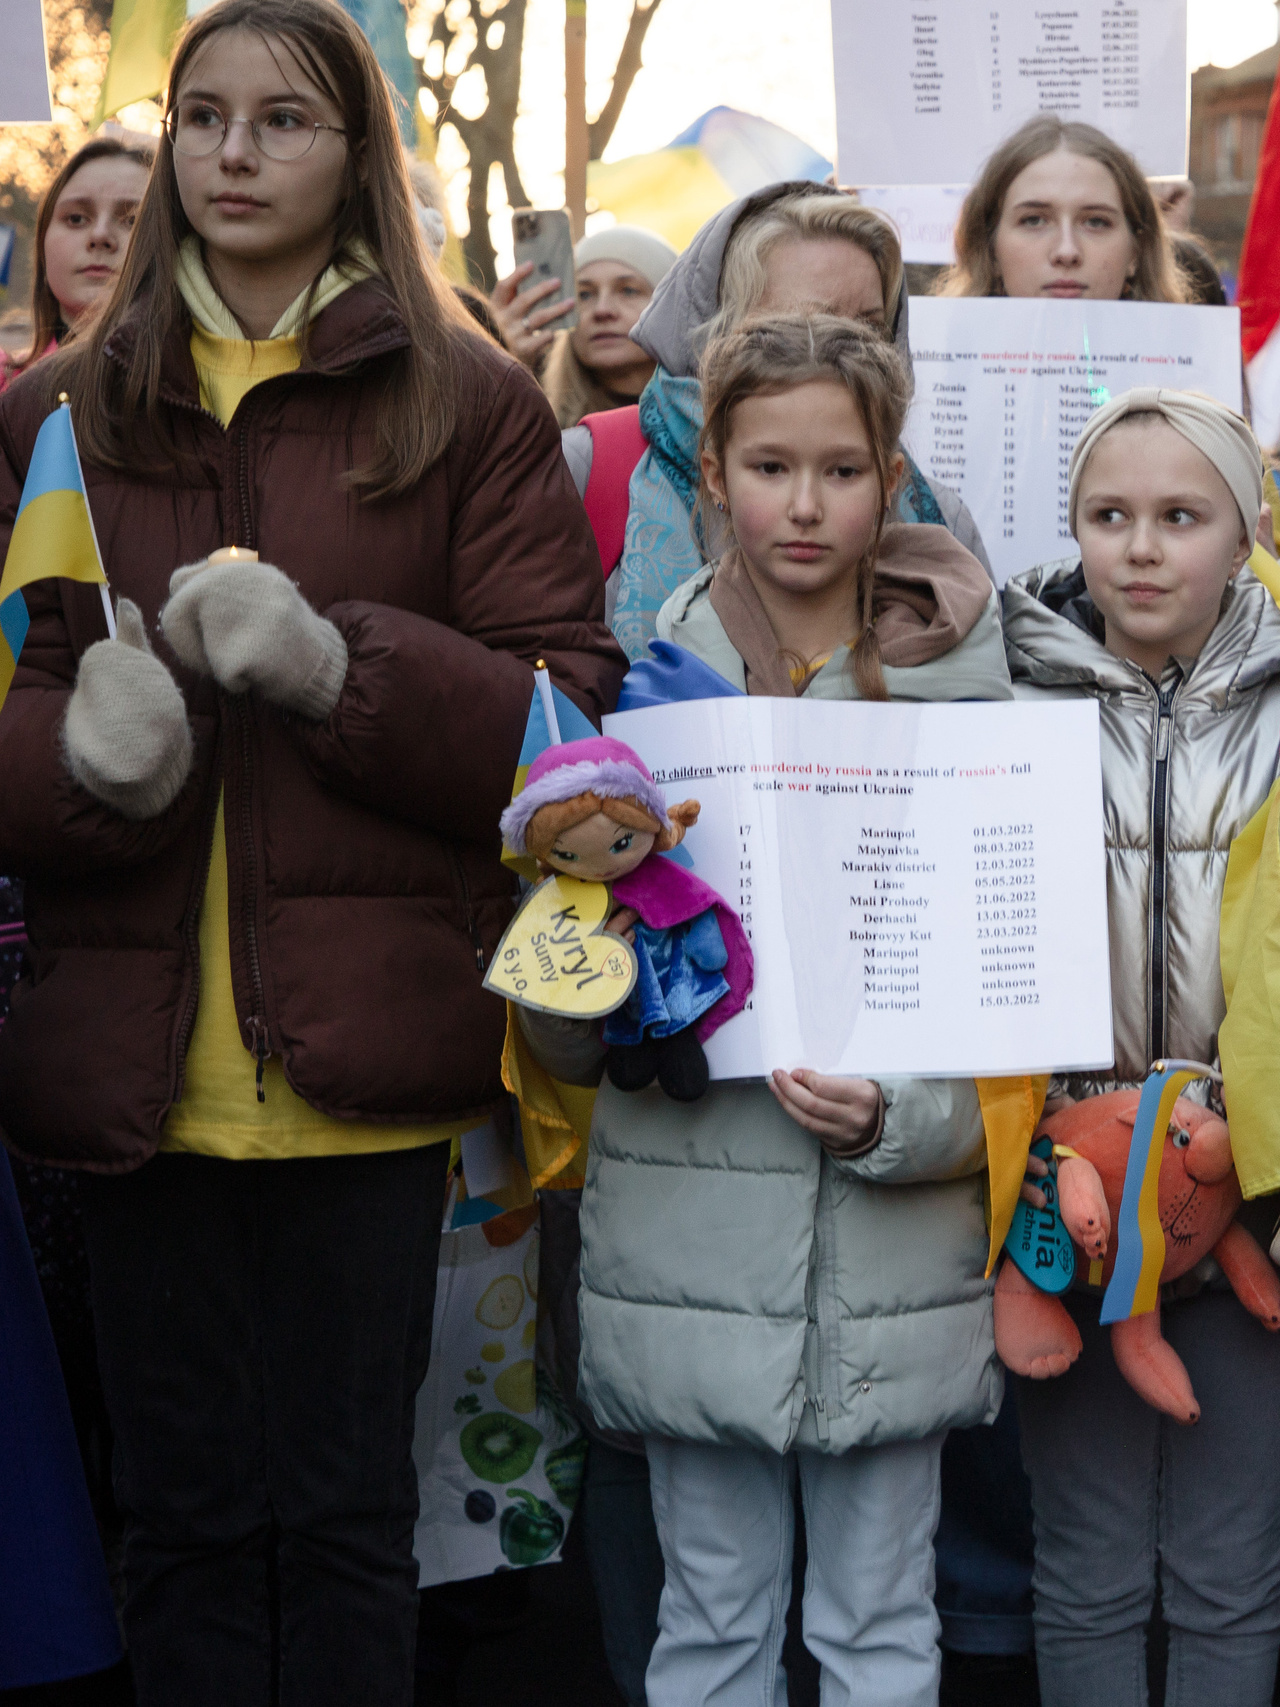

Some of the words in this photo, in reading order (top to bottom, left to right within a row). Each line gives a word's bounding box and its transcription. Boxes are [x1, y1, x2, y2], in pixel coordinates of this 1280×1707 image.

[983, 366, 1006, 374] scale
[1031, 366, 1065, 376] against
[1069, 366, 1107, 376] Ukraine
[668, 766, 712, 780] children
[717, 764, 746, 774] were
[750, 762, 812, 774] murdered
[817, 763, 831, 777] by
[836, 764, 872, 777] russia
[876, 767, 889, 777] as
[893, 767, 900, 777] a
[904, 766, 939, 777] result
[943, 766, 956, 778] of
[959, 765, 1006, 777] russia's
[1011, 762, 1031, 775] full
[752, 780, 783, 791] scale
[788, 781, 811, 792] war
[815, 781, 858, 795] against
[863, 783, 914, 795] Ukraine
[860, 827, 915, 843] Mariupol
[973, 823, 1033, 838] 01.03.2022
[857, 844, 919, 859] Malynivka
[842, 861, 891, 872] Marakiv
[895, 861, 936, 872] district
[874, 879, 905, 889] Lisne
[849, 895, 876, 906] Mali
[880, 895, 929, 909] Prohody
[863, 911, 917, 926] Derhachi
[849, 930, 905, 943] Bobrovyy
[910, 930, 932, 940] Kut
[977, 924, 1037, 939] 23.03.2022
[504, 947, 520, 961] 6
[549, 904, 604, 990] Kyryl
[863, 947, 918, 961] Mariupol
[531, 932, 559, 984] Sumy
[608, 956, 624, 977] 257
[864, 964, 919, 978] Mariupol
[864, 981, 919, 995] Mariupol
[864, 998, 920, 1012] Mariupol
[980, 993, 1040, 1007] 15.03.2022
